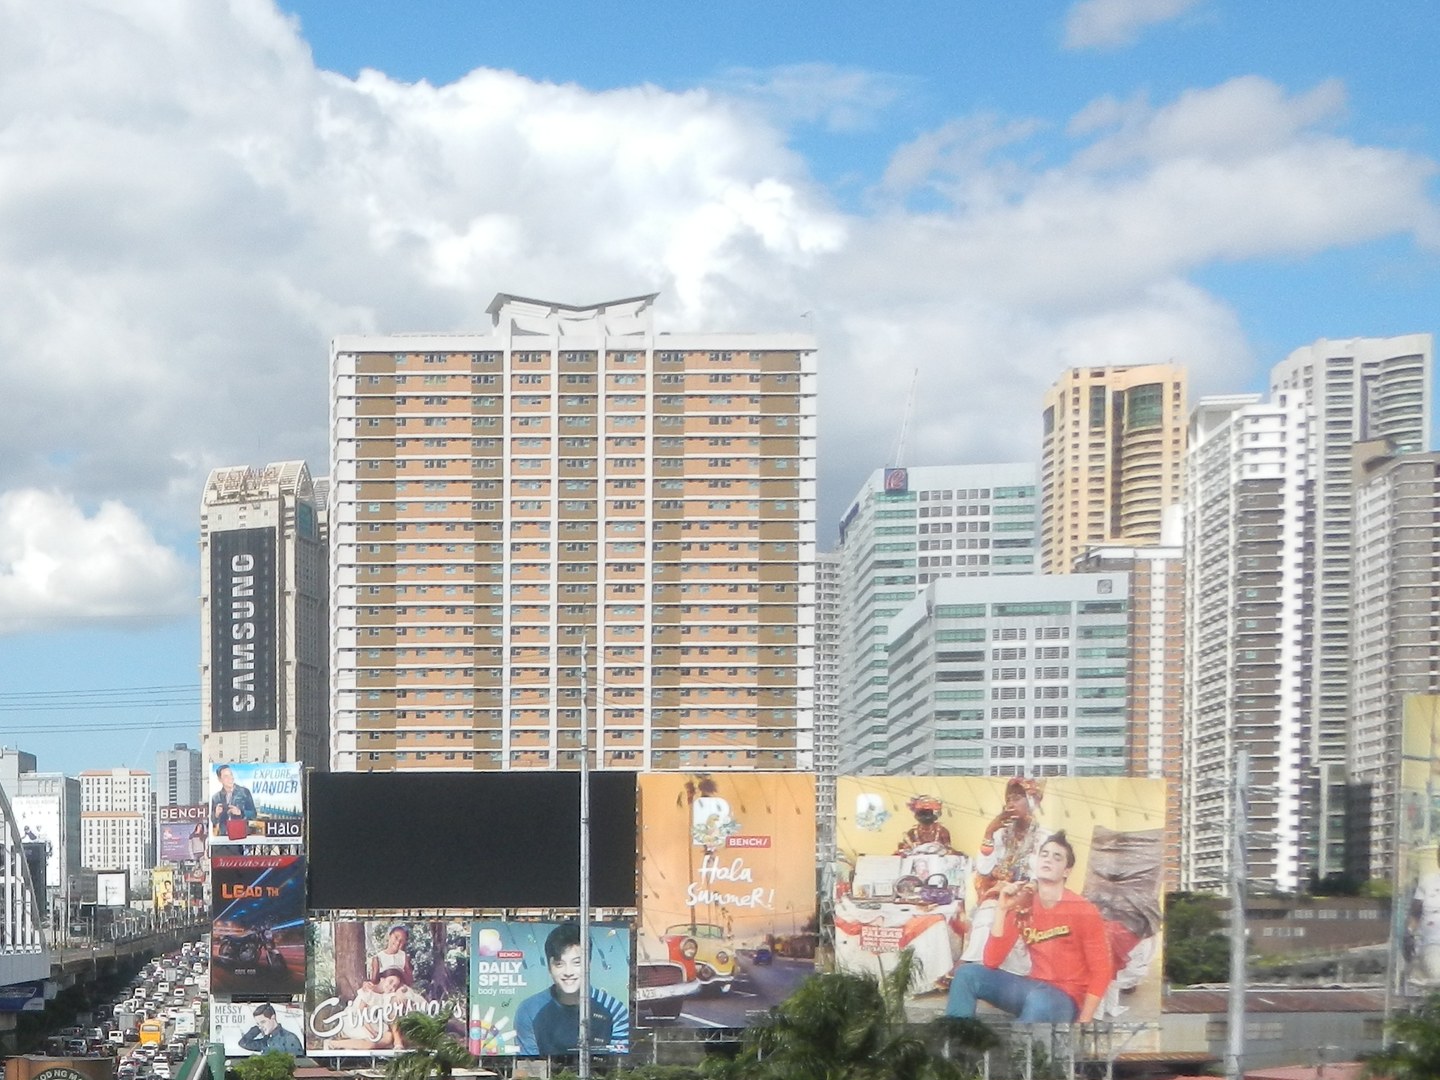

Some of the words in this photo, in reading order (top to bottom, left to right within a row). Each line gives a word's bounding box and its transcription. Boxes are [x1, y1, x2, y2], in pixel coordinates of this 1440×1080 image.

[232, 554, 256, 713] SAMSUNG
[253, 769, 291, 779] EXPLORE
[252, 781, 299, 794] WANDER
[221, 883, 263, 900] LEAD
[479, 962, 522, 973] DAILY
[478, 975, 527, 986] SPELL
[478, 987, 497, 996] body
[499, 987, 515, 995] mist
[215, 1005, 243, 1014] MESSY
[215, 1015, 229, 1024] SET
[231, 1015, 246, 1024] GO!
[53, 1069, 68, 1079] NG
